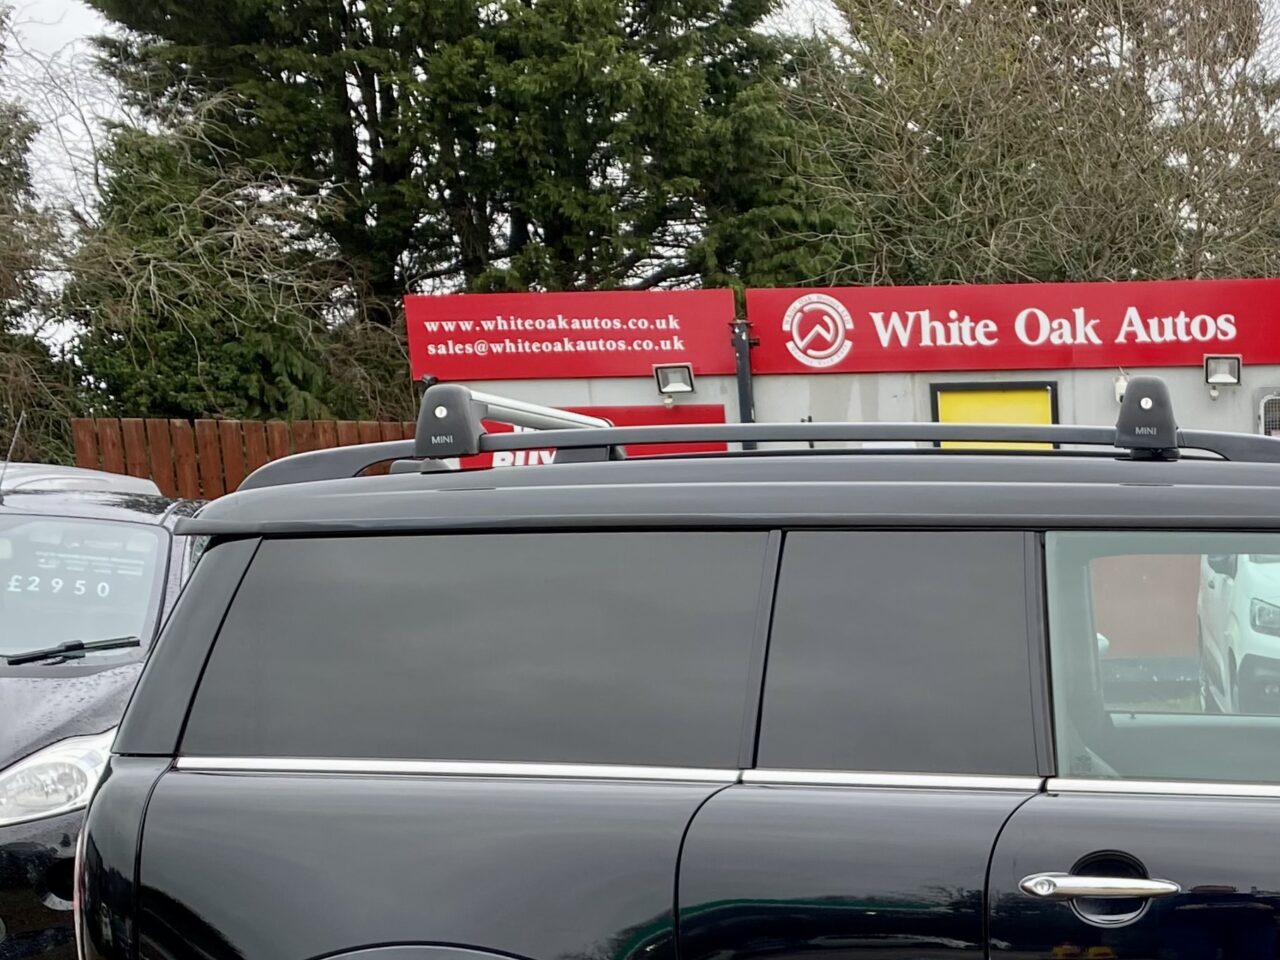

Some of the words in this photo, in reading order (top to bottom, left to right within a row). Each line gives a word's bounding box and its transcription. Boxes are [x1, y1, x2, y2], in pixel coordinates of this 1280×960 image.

[423, 315, 681, 333] www.whiteoakautos.co.uk
[869, 308, 999, 348] White
[1014, 307, 1103, 346] Oak
[1114, 306, 1237, 344] Autos
[427, 336, 686, 356] sales@whiteoakautos.co.uk
[1135, 426, 1157, 435] MINI
[431, 435, 454, 445] MINI
